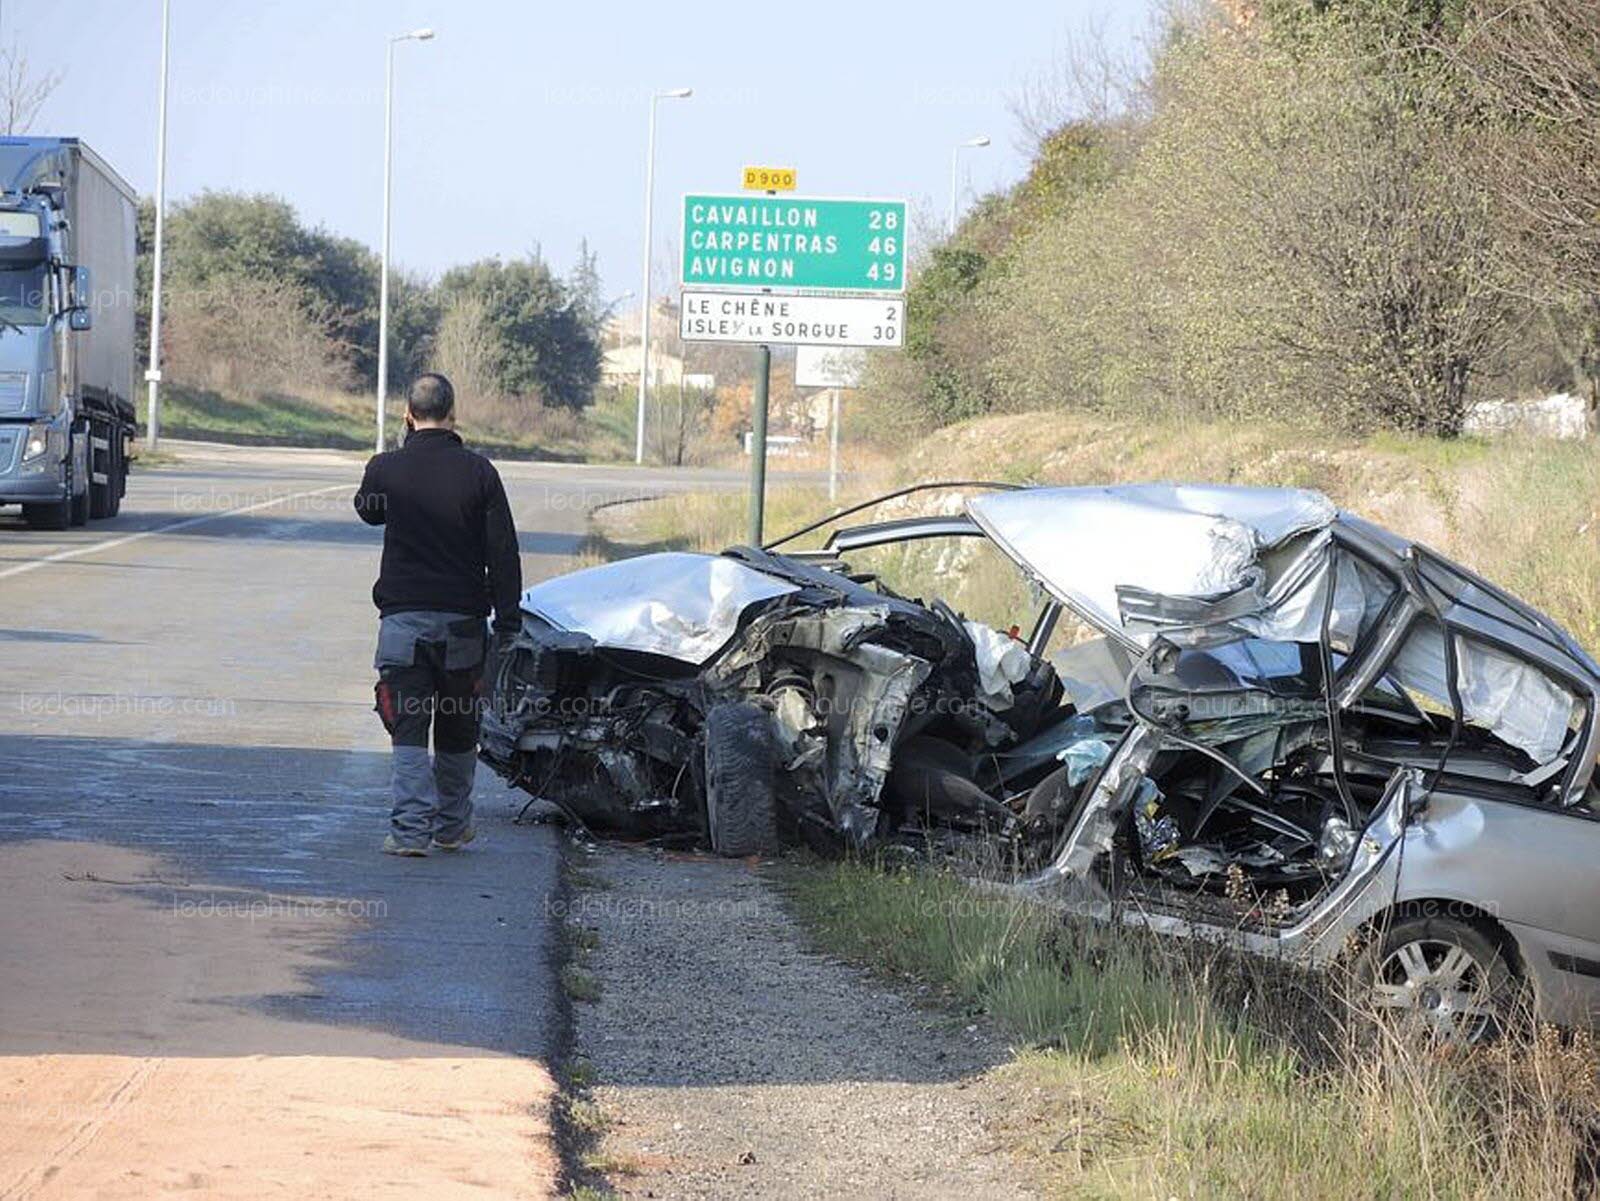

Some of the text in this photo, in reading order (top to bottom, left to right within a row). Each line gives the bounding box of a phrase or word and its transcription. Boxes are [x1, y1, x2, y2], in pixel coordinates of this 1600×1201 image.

[692, 205, 898, 230] CAVAILLON 28
[691, 231, 897, 256] CARPENTRAS 46
[690, 257, 897, 282] AVIGNON 49
[688, 300, 711, 315] LE
[721, 298, 791, 318] CHÊNE
[886, 307, 898, 322] 2
[687, 319, 729, 335] ISLE
[772, 322, 849, 339] SORGUE
[873, 326, 897, 341] 30
